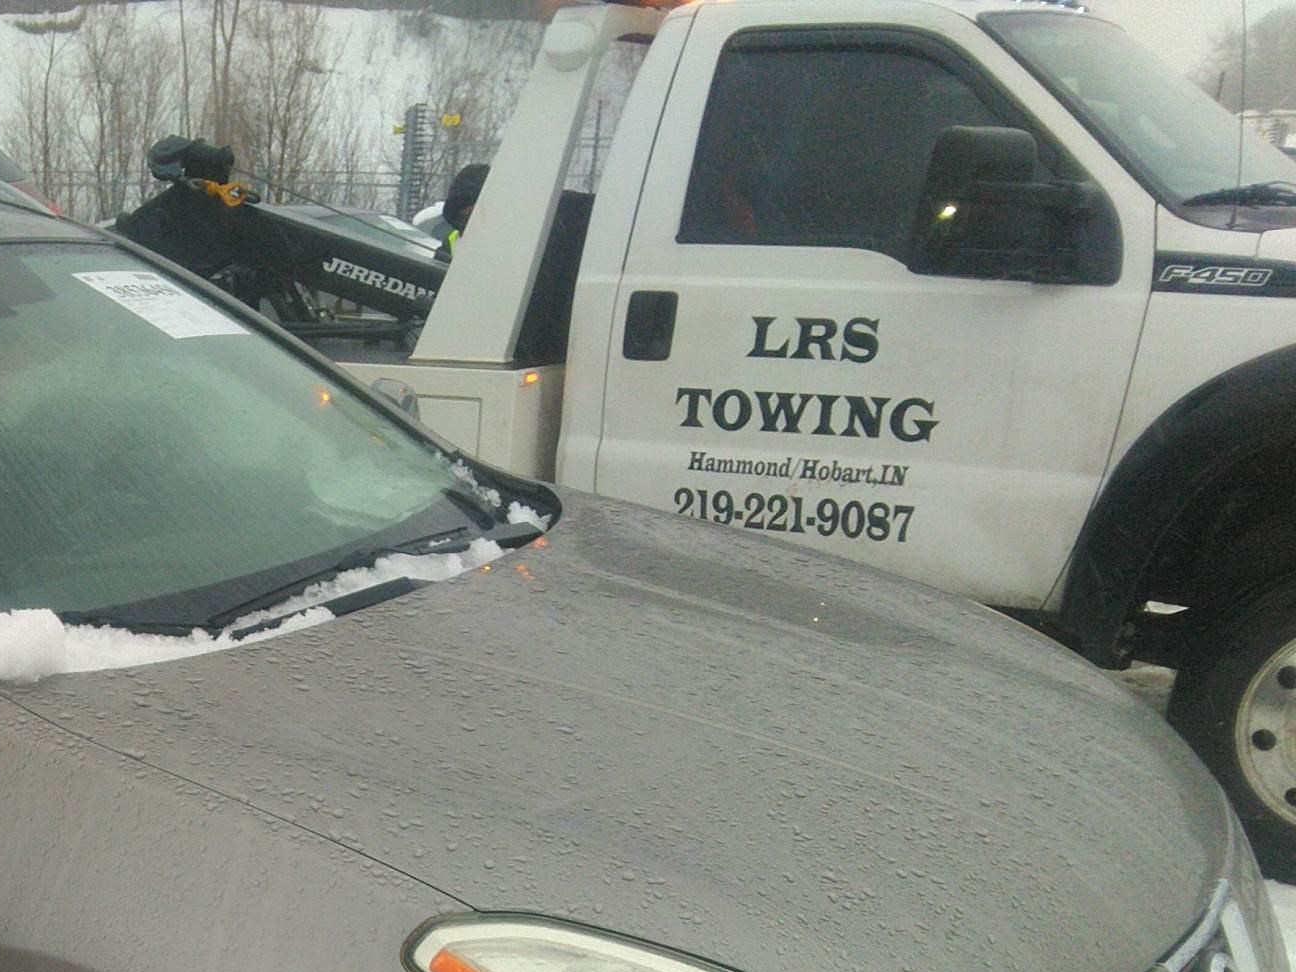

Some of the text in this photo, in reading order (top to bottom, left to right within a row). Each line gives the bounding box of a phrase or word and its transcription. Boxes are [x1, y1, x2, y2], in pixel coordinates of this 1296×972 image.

[1160, 265, 1272, 286] F-450
[746, 316, 880, 363] LRS
[676, 387, 940, 442] TOWING
[674, 487, 915, 542] 219-221-9087
